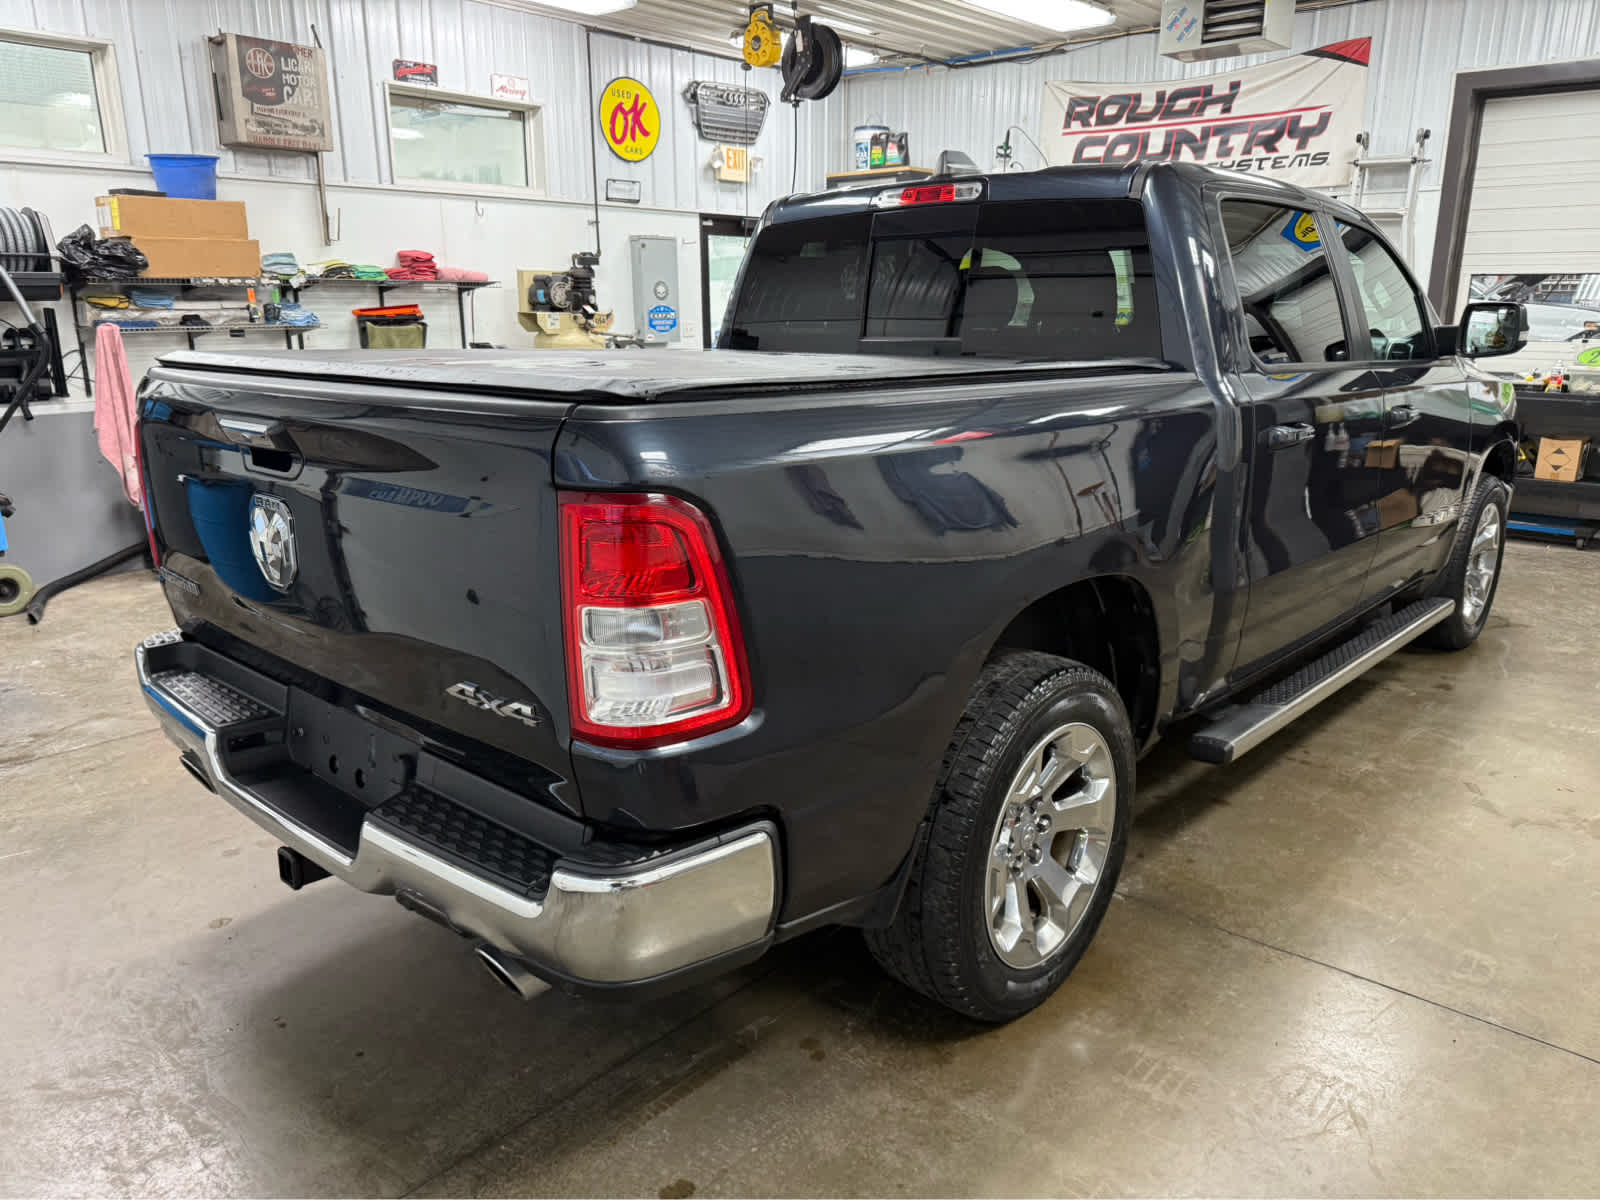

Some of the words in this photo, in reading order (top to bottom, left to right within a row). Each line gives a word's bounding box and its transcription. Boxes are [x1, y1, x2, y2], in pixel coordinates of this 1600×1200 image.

[282, 73, 317, 88] MOTOR
[611, 87, 632, 100] USED
[1064, 80, 1242, 130] ROUGH
[610, 92, 651, 146] OK
[1072, 111, 1333, 164] COUNTRY
[726, 147, 747, 169] EXIT
[1207, 151, 1330, 172] YSTEMS
